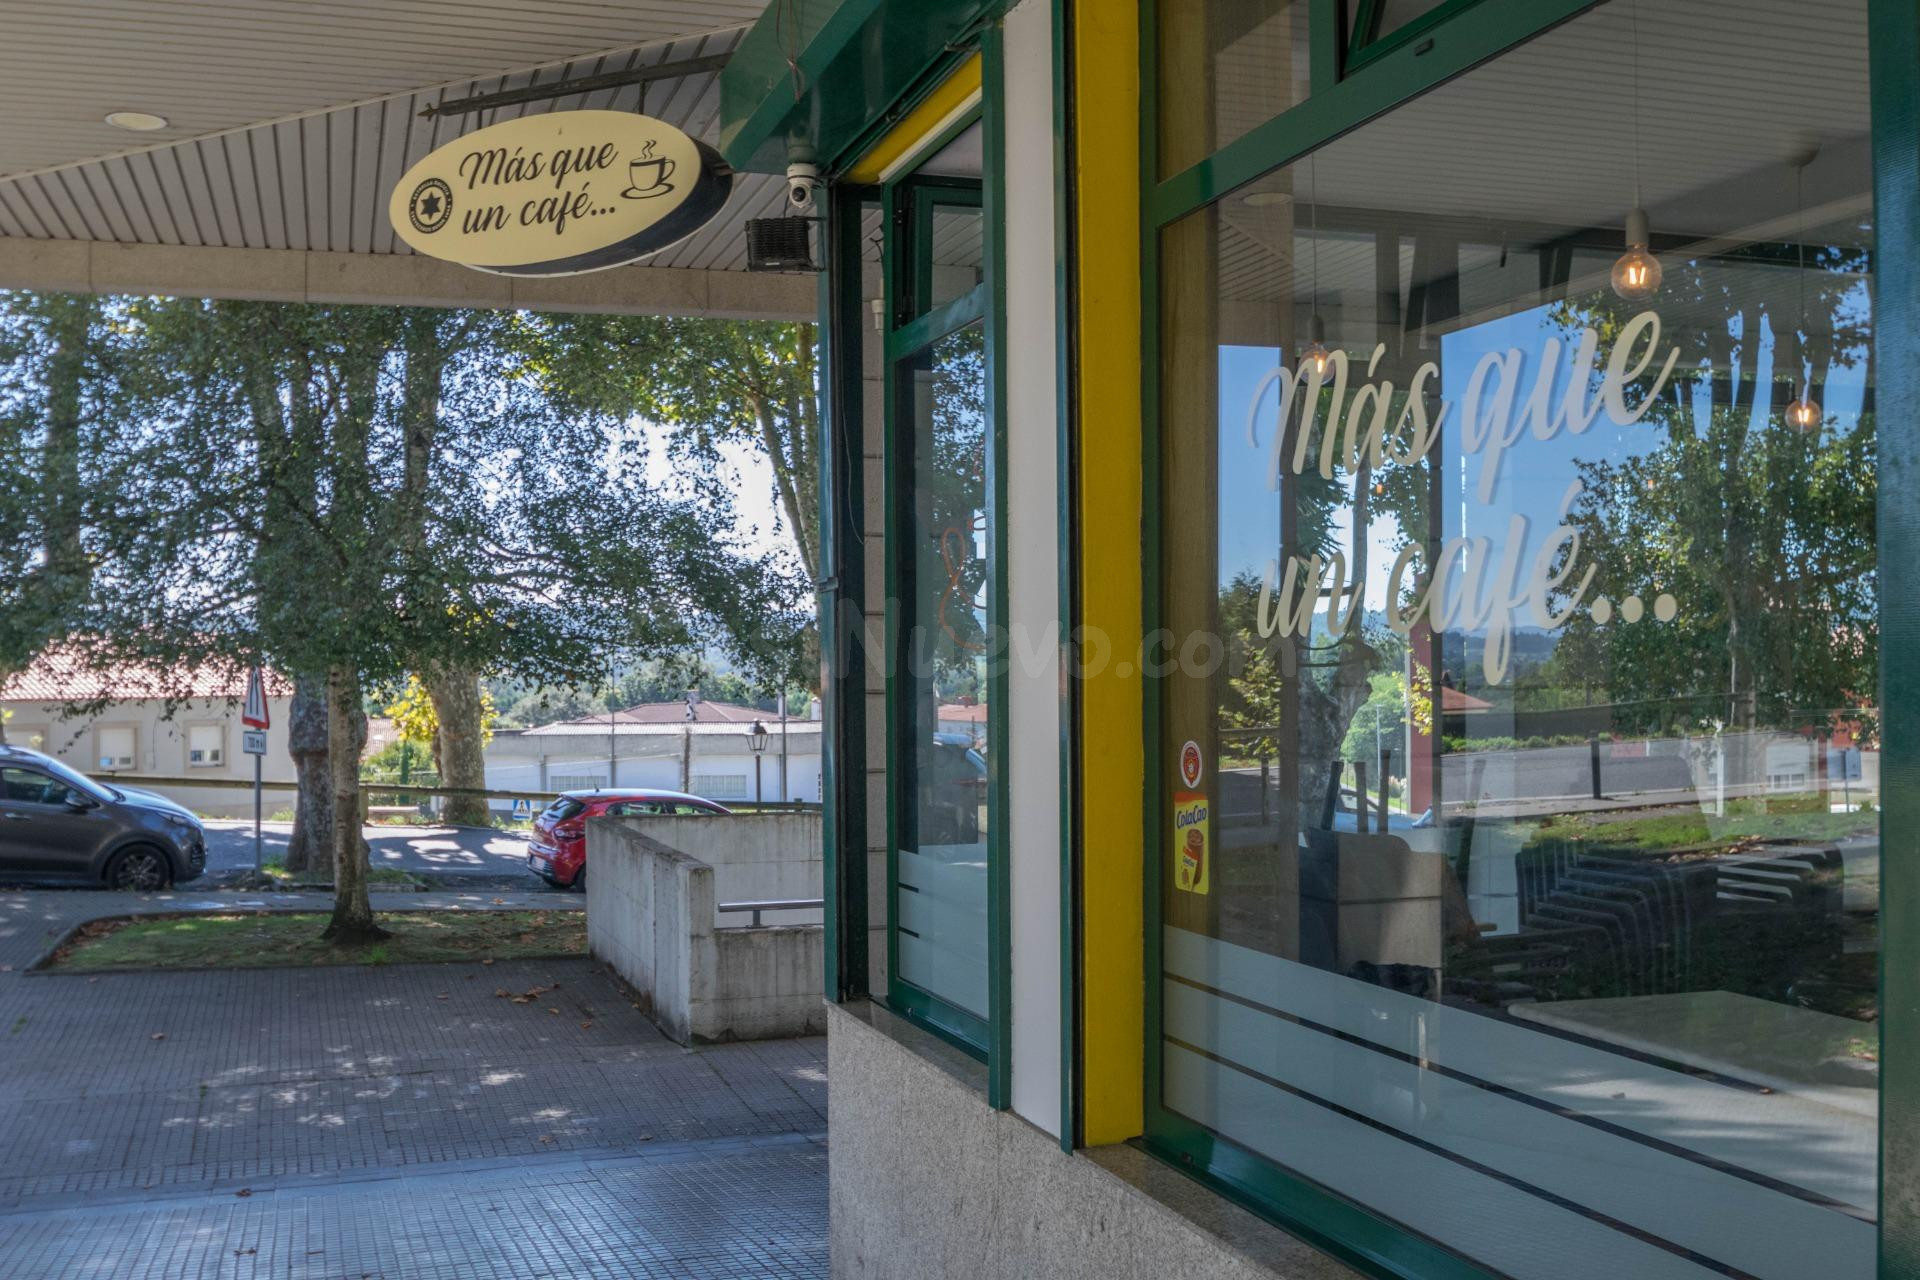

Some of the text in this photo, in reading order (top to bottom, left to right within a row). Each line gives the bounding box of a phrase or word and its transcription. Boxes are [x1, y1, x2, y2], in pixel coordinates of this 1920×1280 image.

[459, 142, 619, 190] Más que
[462, 204, 510, 235] un
[519, 181, 616, 235] café...
[1246, 311, 1681, 505] Más que
[1257, 480, 1678, 686] un café...
